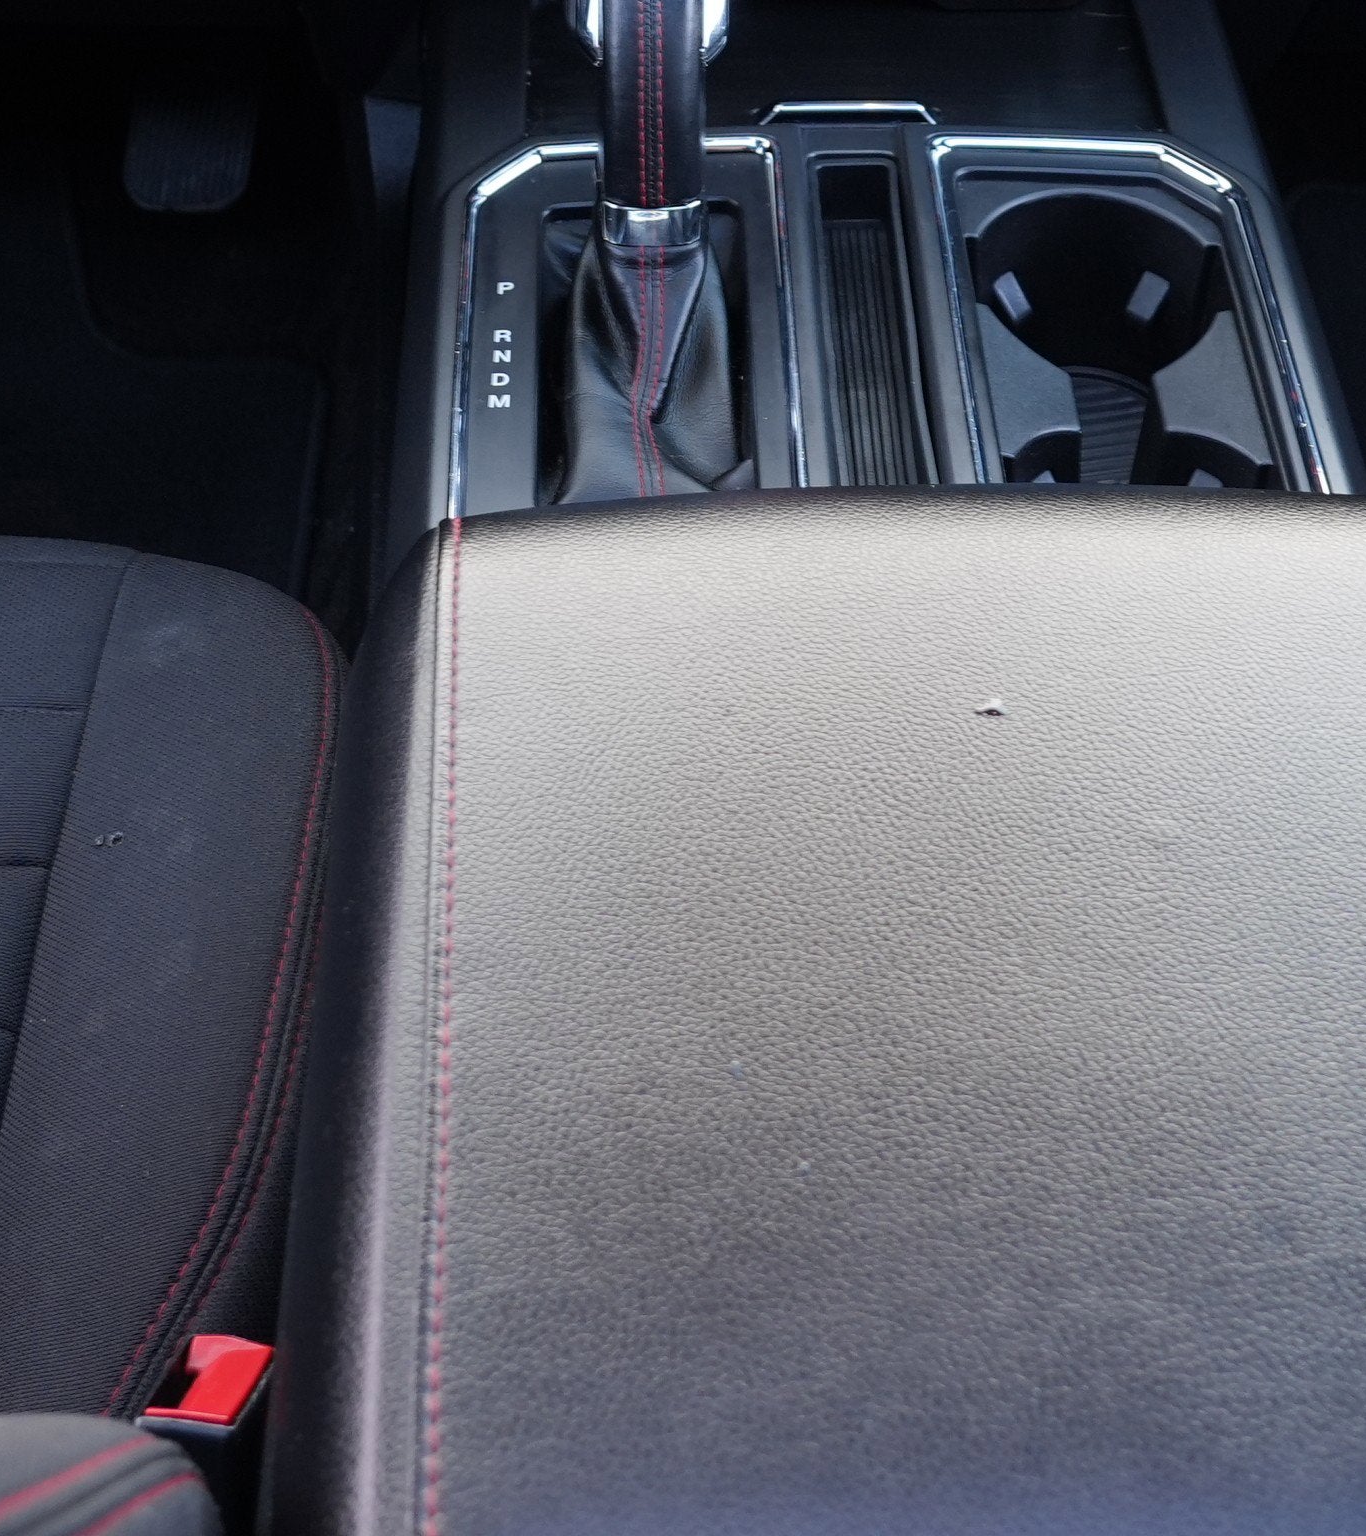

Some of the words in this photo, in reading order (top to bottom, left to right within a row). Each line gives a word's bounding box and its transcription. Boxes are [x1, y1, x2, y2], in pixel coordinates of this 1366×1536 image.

[496, 282, 515, 295] P
[493, 329, 512, 343] R
[492, 350, 511, 363] N
[490, 373, 510, 386] D
[487, 394, 511, 408] M
